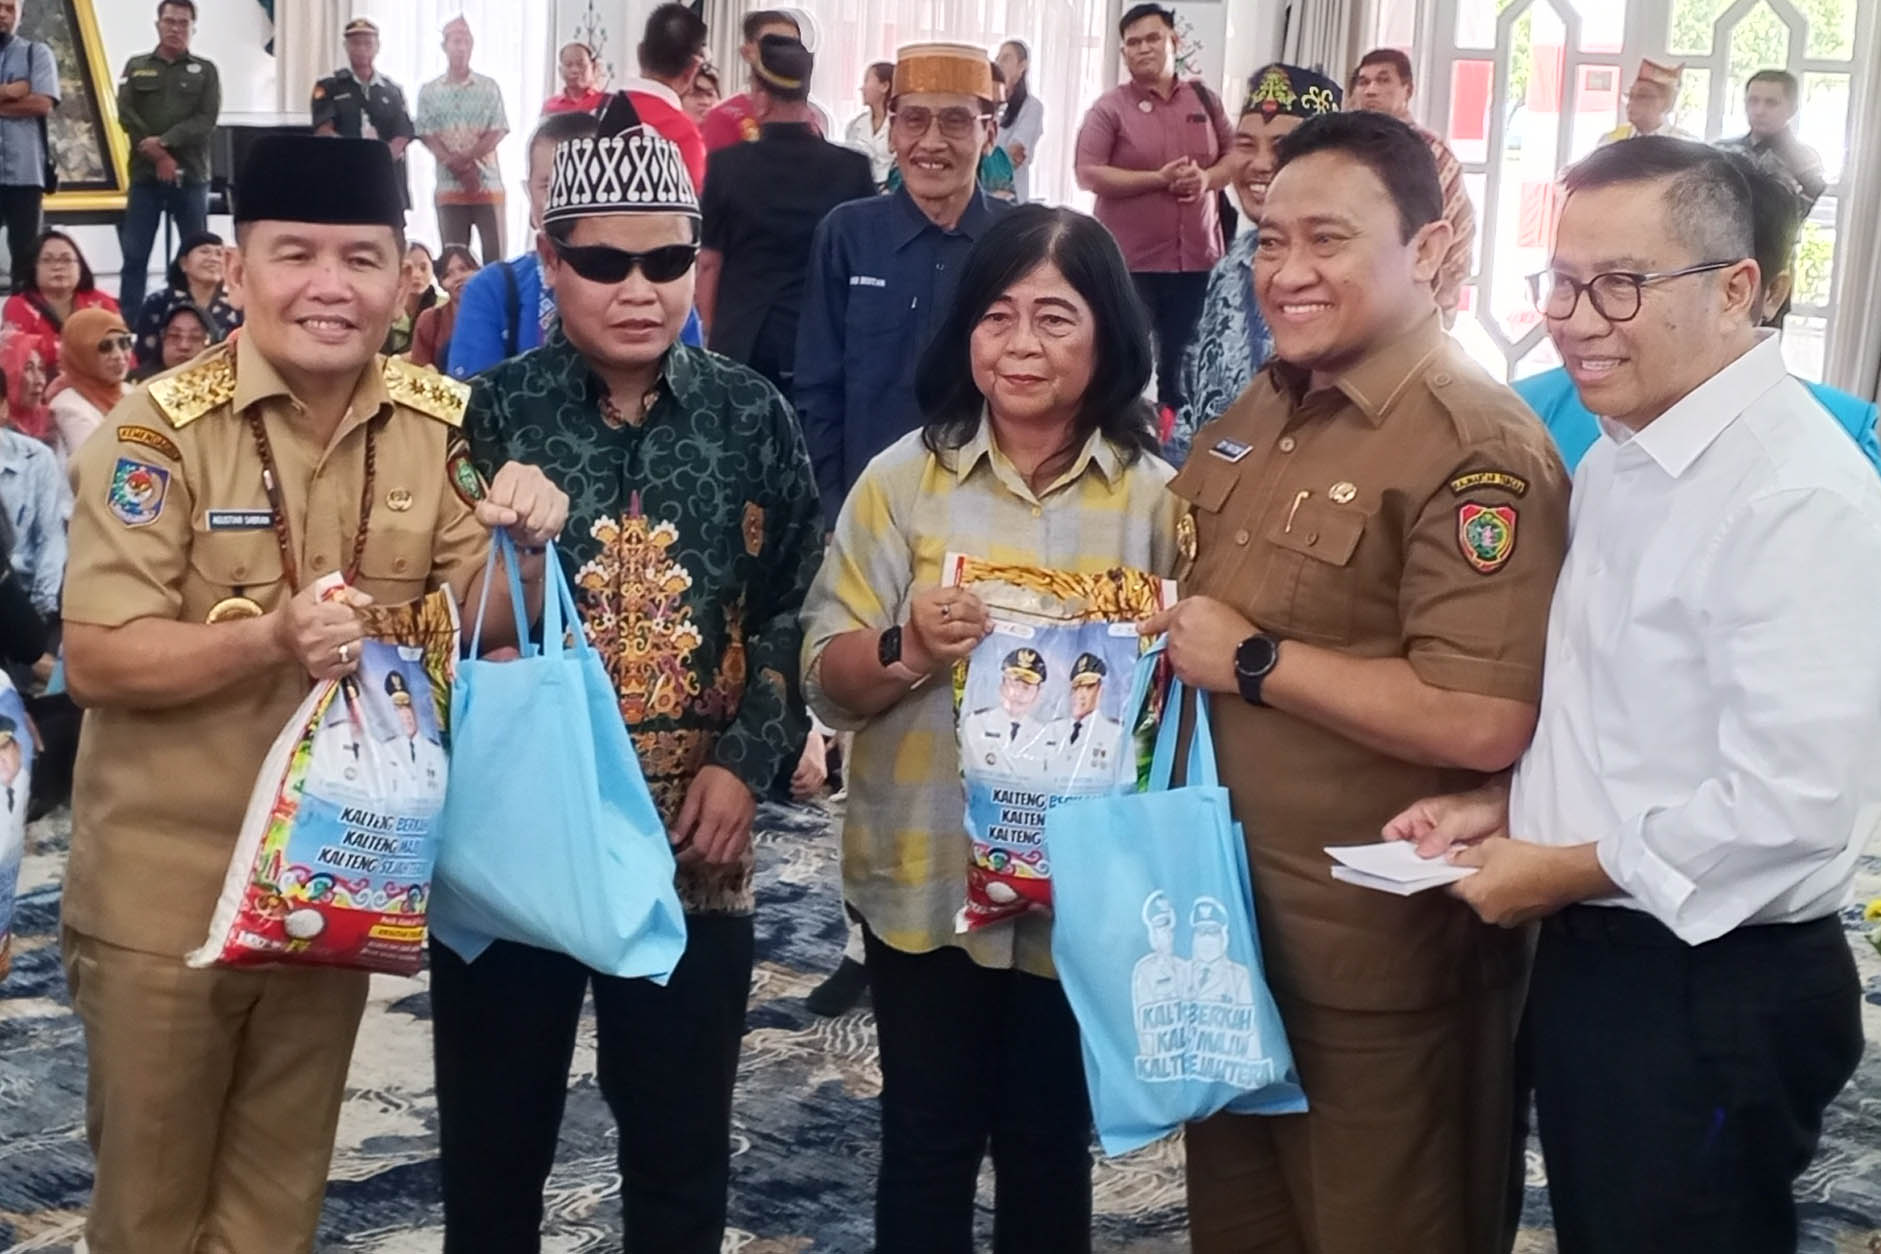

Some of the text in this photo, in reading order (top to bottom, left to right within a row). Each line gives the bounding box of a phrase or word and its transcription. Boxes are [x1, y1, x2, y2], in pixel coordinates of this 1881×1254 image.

[992, 788, 1046, 808] KALTENG
[340, 806, 395, 831] KALTENG
[1002, 808, 1046, 827] KALTEN
[342, 829, 398, 854] KALTENG
[988, 826, 1042, 846] KALTENG
[318, 847, 379, 873] KALTENG
